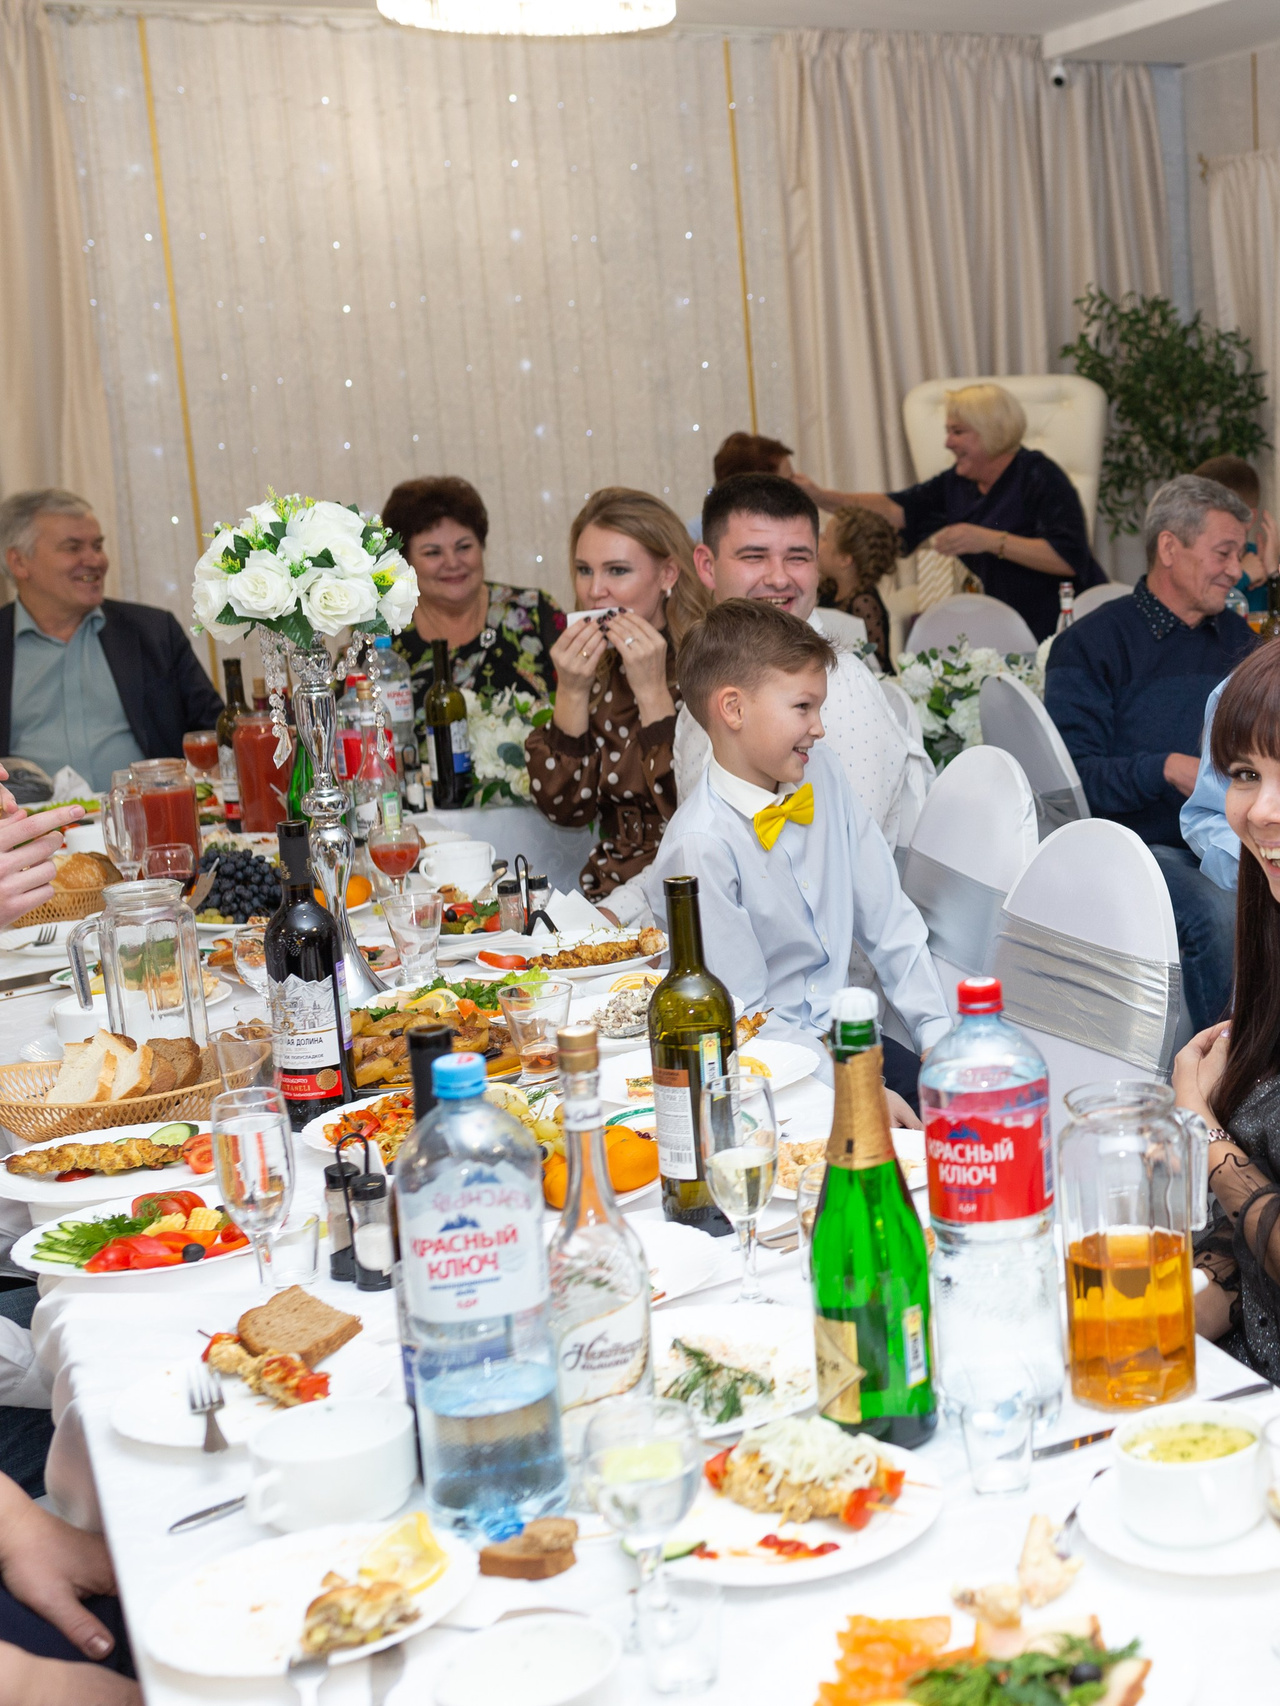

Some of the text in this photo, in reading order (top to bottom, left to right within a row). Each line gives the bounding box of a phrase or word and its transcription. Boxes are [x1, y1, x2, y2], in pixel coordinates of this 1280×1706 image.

[296, 1037, 324, 1047] ДОЛИНА
[928, 1137, 1014, 1164] КРАСНЫЙ
[938, 1164, 997, 1186] КЛЮЧ
[427, 1251, 500, 1281] КЛЮЧ
